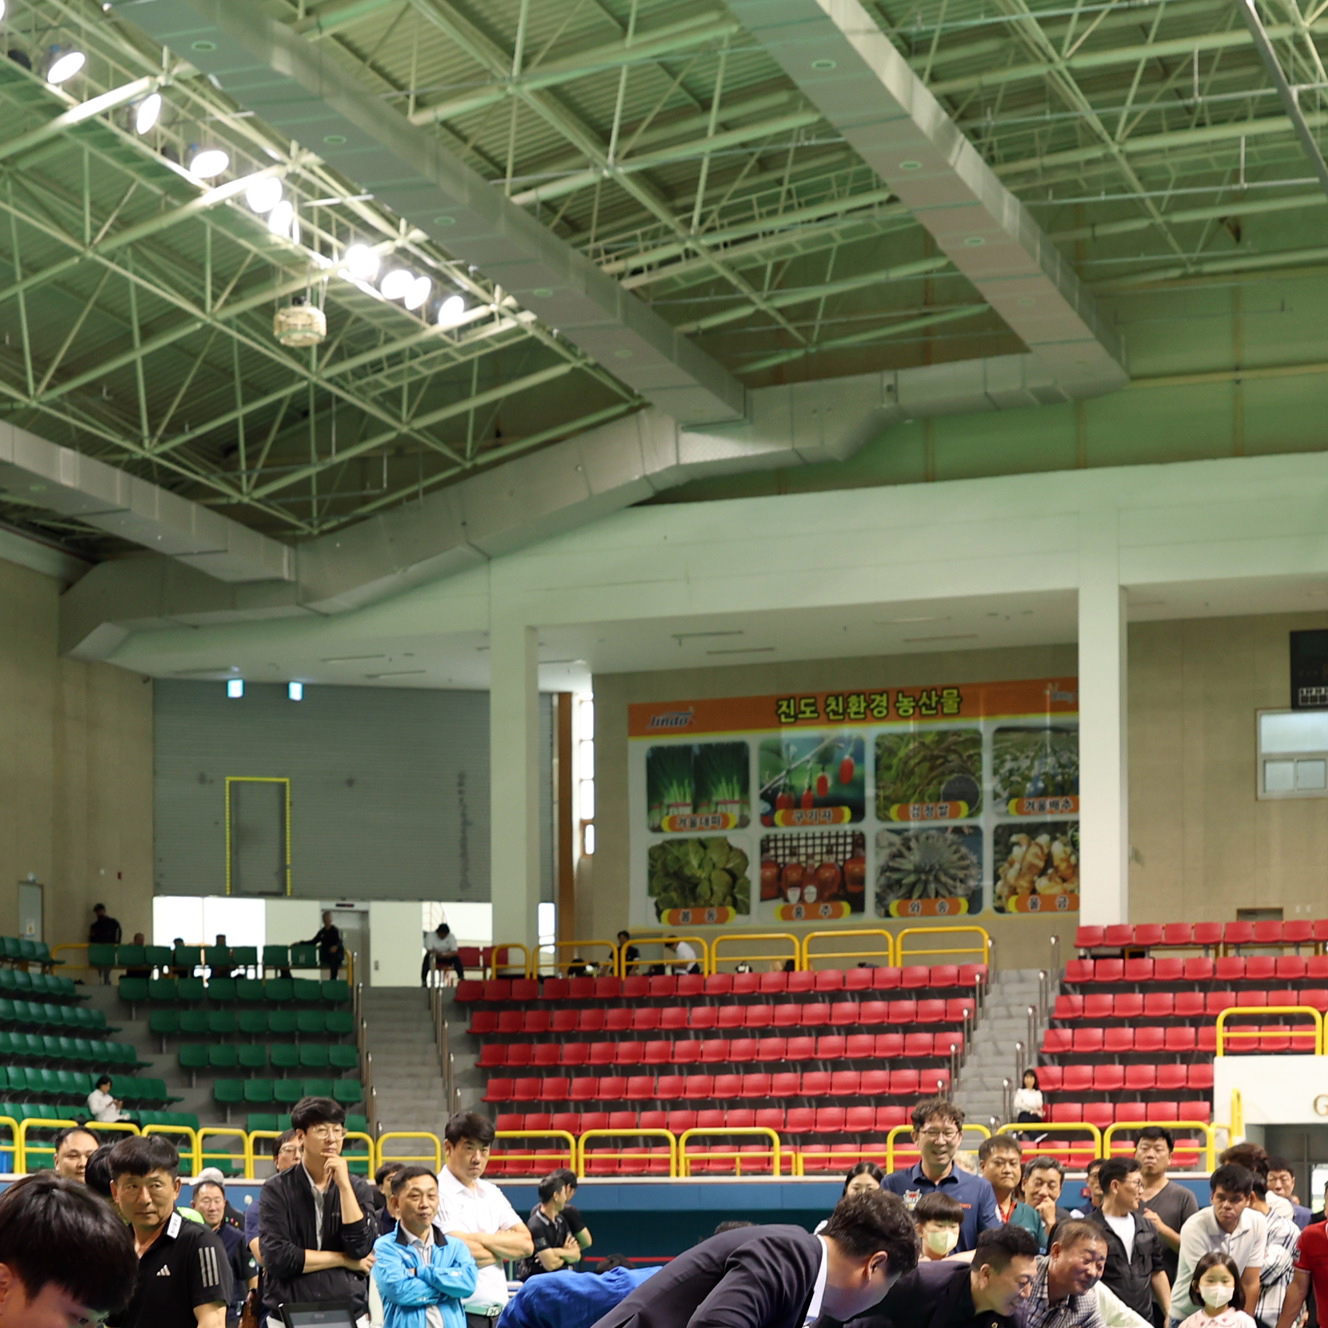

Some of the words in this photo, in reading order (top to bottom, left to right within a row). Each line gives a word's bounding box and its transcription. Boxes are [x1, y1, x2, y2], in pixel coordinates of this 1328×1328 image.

[776, 696, 820, 724] 진도
[825, 692, 889, 721] 친환경
[895, 687, 962, 718] 농산물
[646, 713, 690, 729] Jindo
